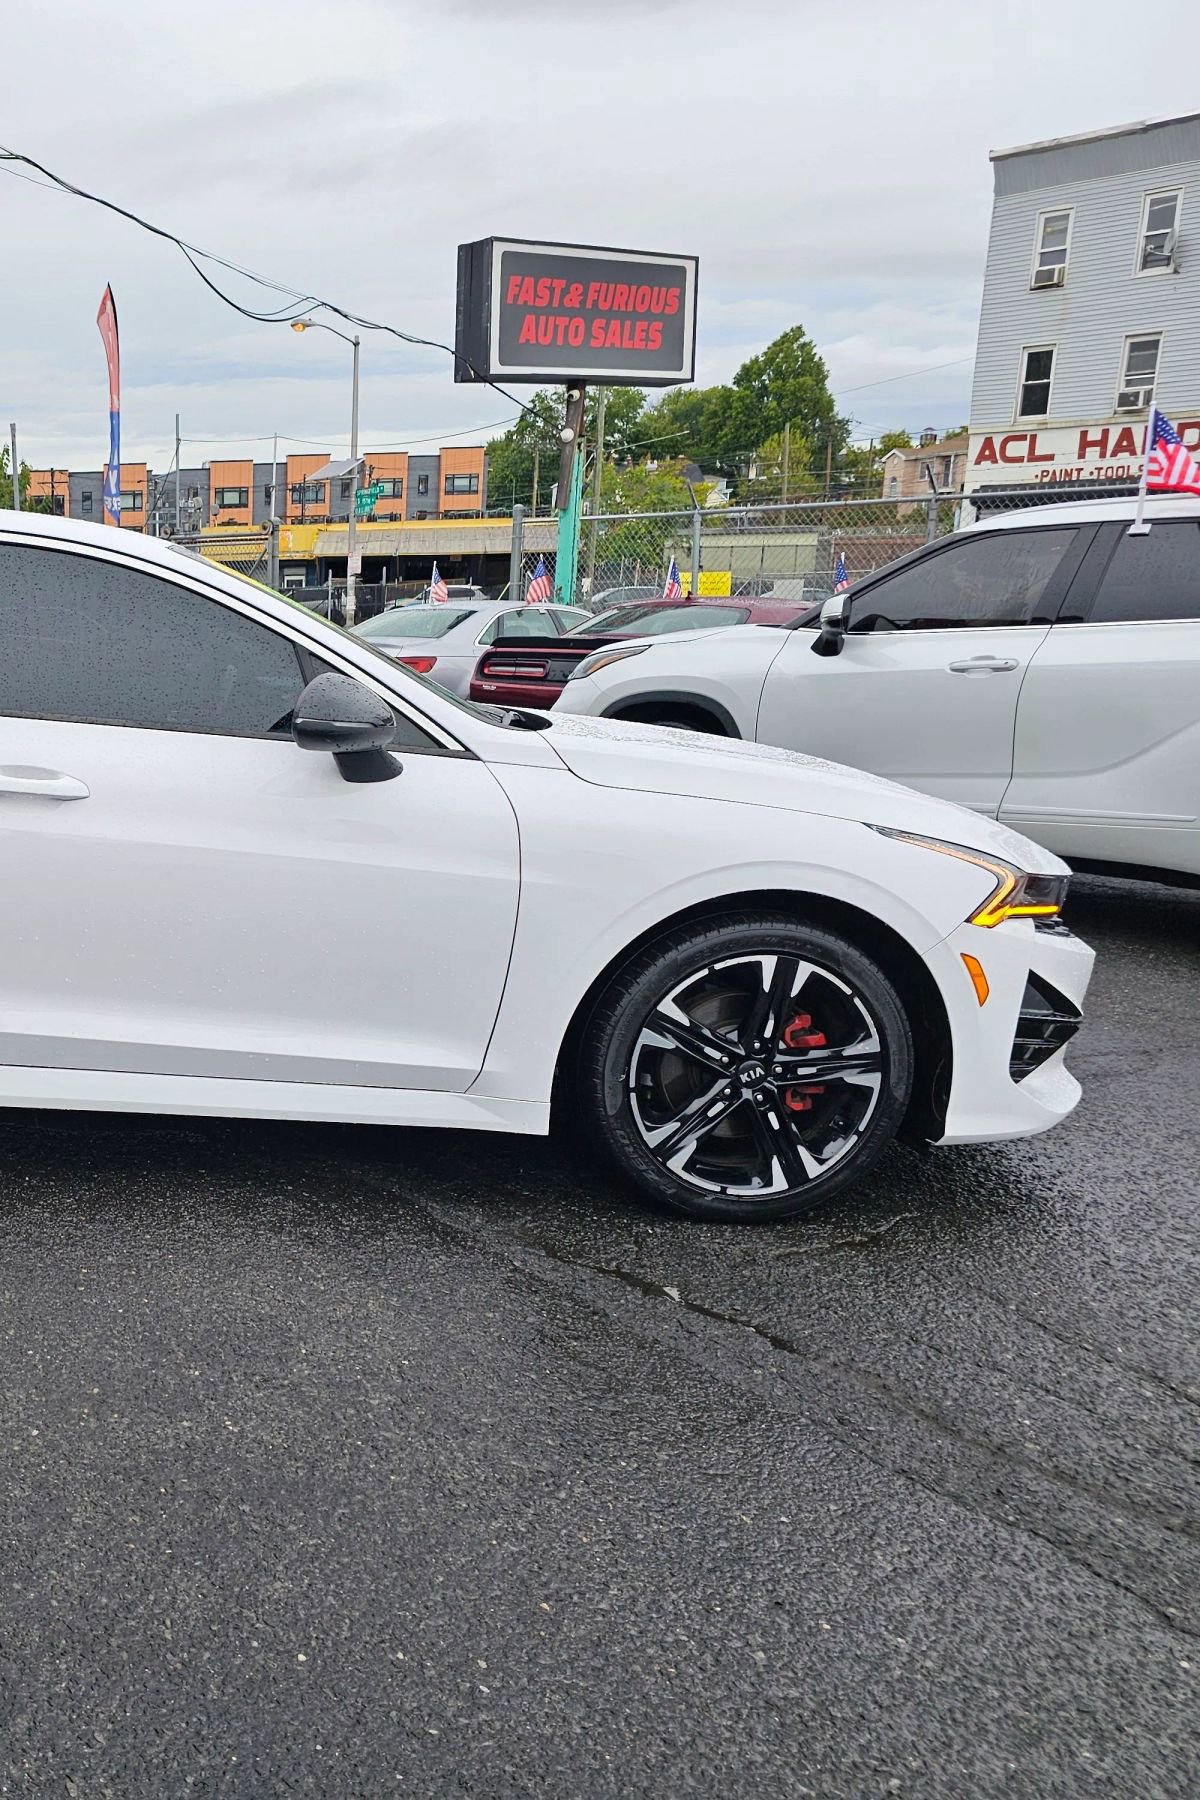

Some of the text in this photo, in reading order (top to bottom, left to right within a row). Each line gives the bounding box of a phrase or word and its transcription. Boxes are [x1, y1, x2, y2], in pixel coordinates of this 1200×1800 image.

[586, 282, 680, 315] FURIOUS
[518, 314, 664, 350] AUTO SALES
[974, 421, 1200, 465] ACL HAD
[1040, 467, 1084, 482] PAINT
[739, 1066, 765, 1083] KIA
